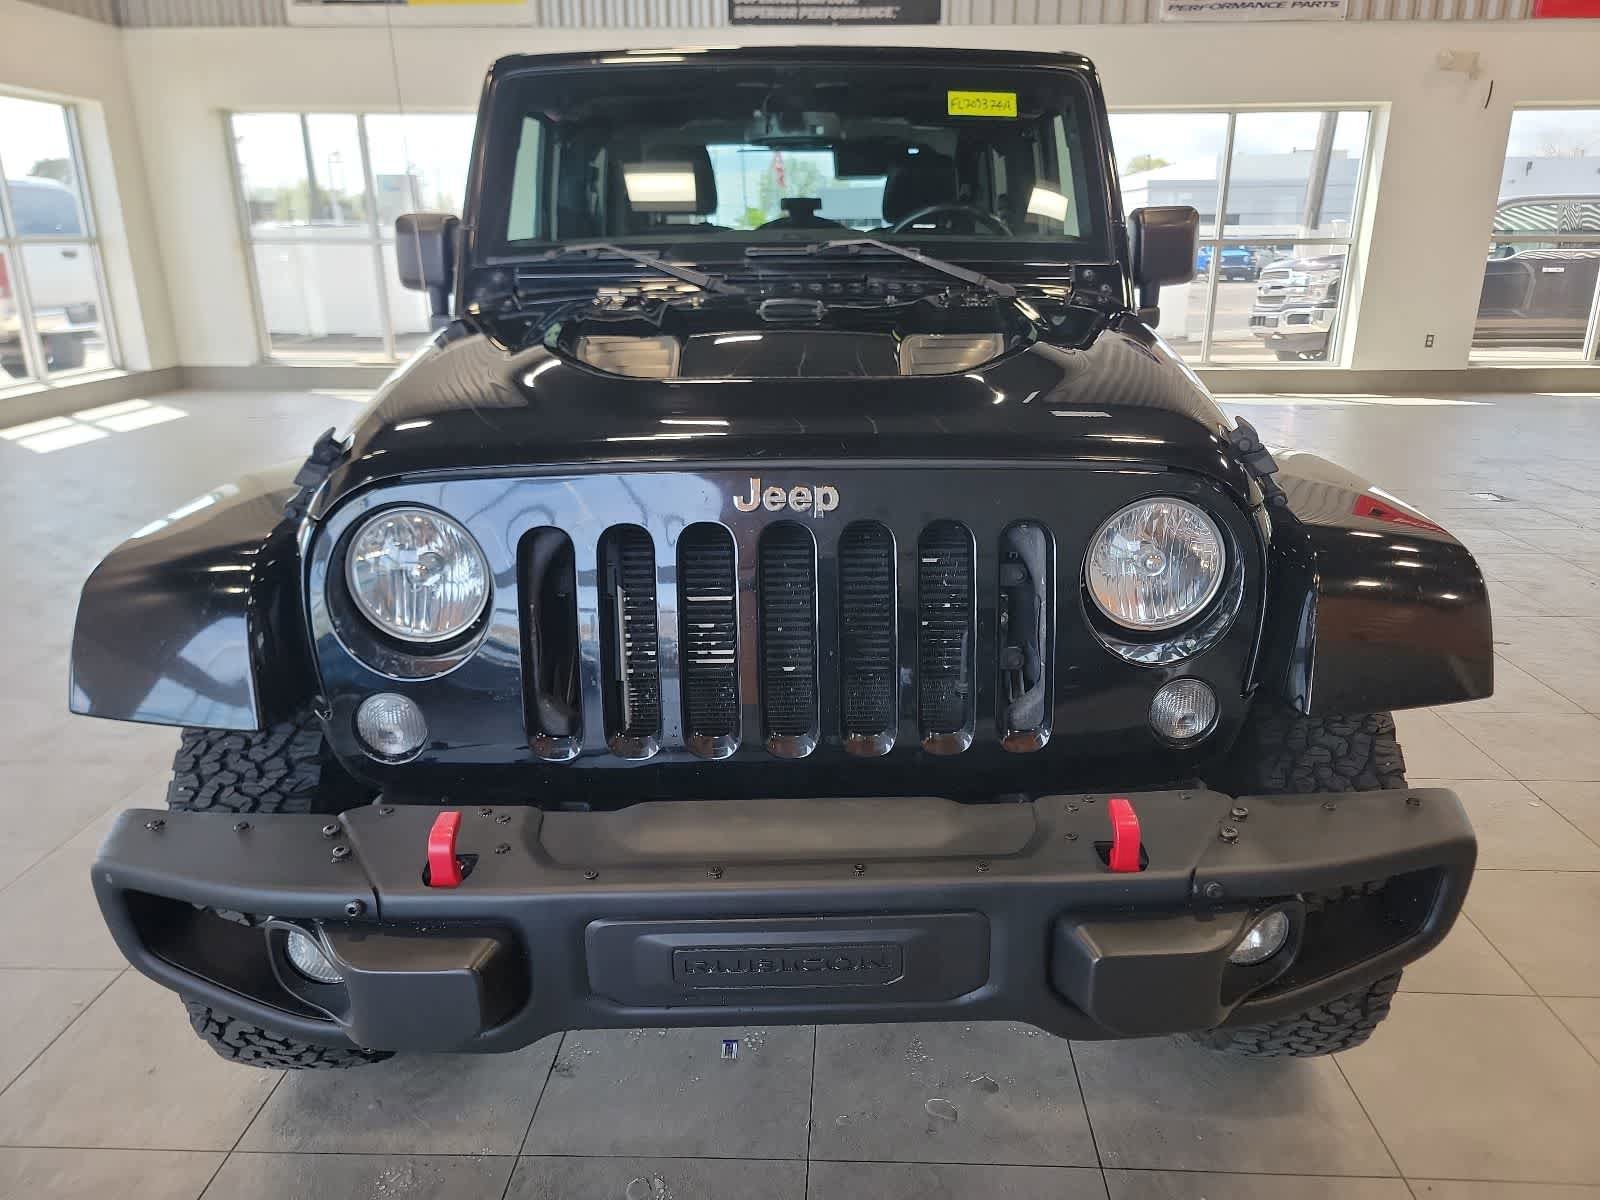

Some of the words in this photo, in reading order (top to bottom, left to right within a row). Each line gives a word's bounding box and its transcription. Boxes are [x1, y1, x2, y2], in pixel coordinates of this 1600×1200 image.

[1167, 0, 1287, 12] PERFORMANCE
[1290, 0, 1341, 9] PARTS
[733, 478, 840, 518] Jeep
[684, 957, 892, 974] RUBICON
